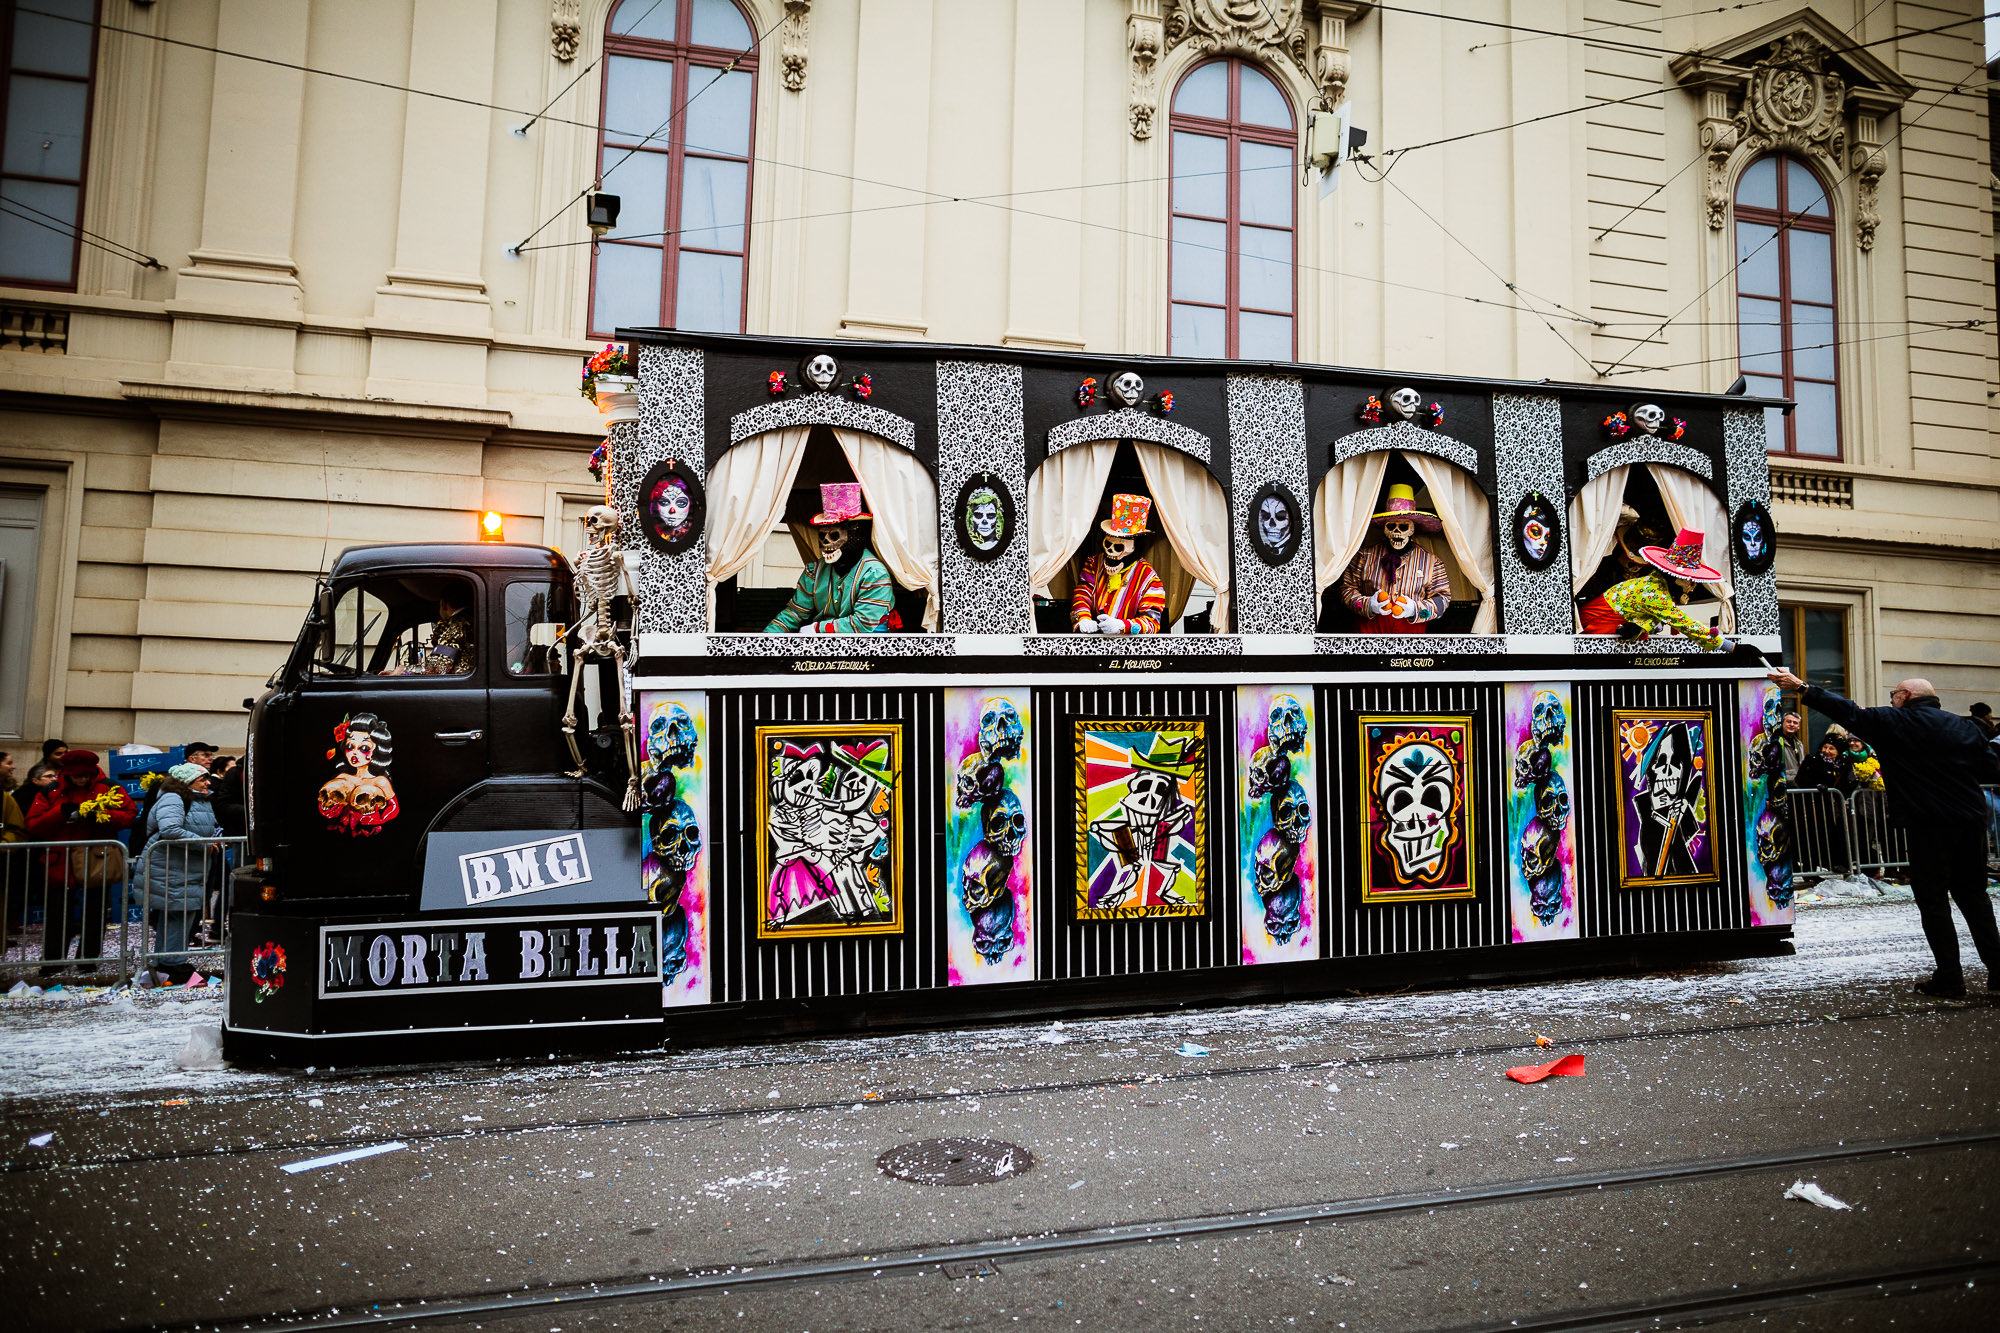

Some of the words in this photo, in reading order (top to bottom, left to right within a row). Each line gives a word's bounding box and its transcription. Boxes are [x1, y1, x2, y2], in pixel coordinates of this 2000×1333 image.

[824, 660, 838, 671] DE
[1109, 659, 1121, 669] EL
[1634, 657, 1643, 666] EL
[469, 839, 580, 900] BMG
[327, 931, 489, 987] MORTA
[519, 924, 656, 979] BELLA
